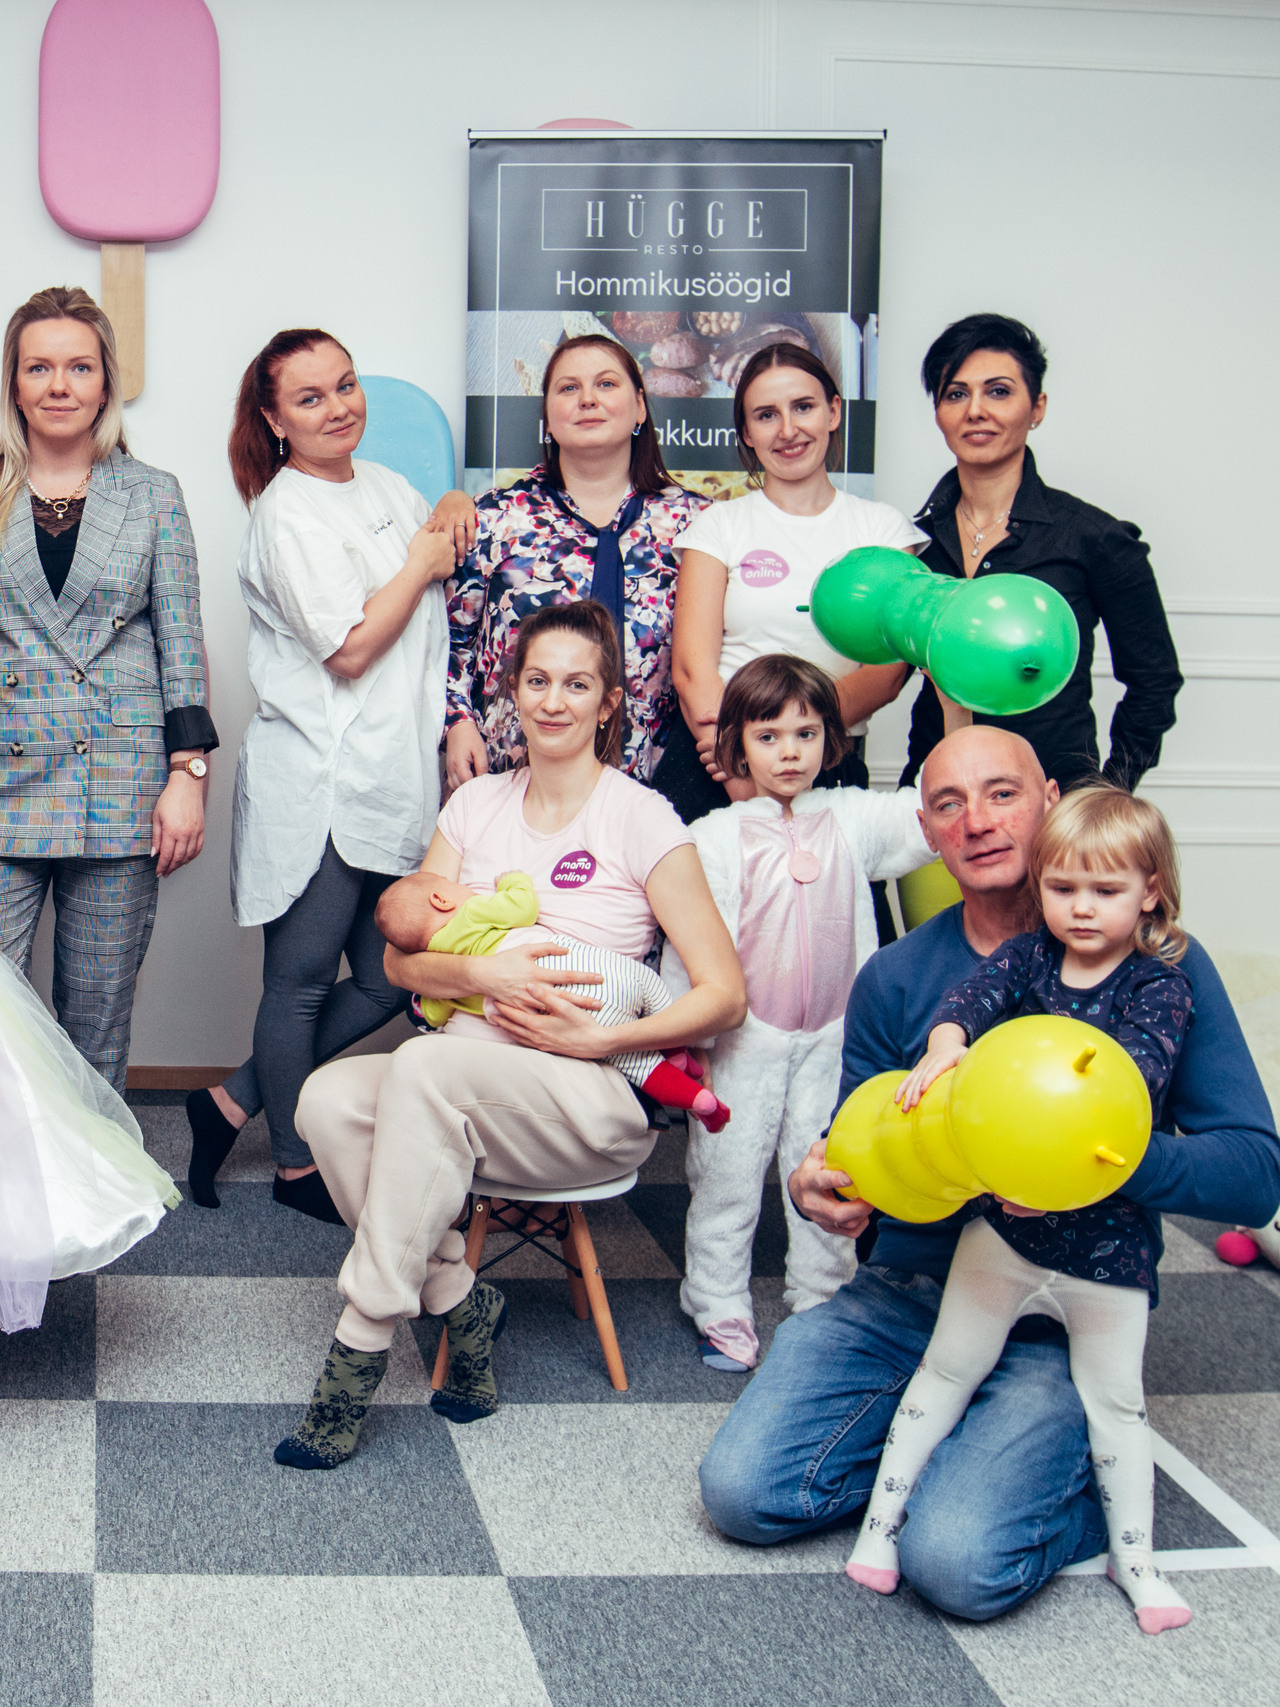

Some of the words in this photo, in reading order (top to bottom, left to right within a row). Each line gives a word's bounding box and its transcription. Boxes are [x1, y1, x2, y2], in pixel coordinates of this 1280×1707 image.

[585, 194, 764, 239] HÜGGE
[644, 245, 704, 255] RESTO
[556, 270, 792, 303] Hommikusöögid
[745, 566, 783, 579] online
[554, 872, 588, 883] online
